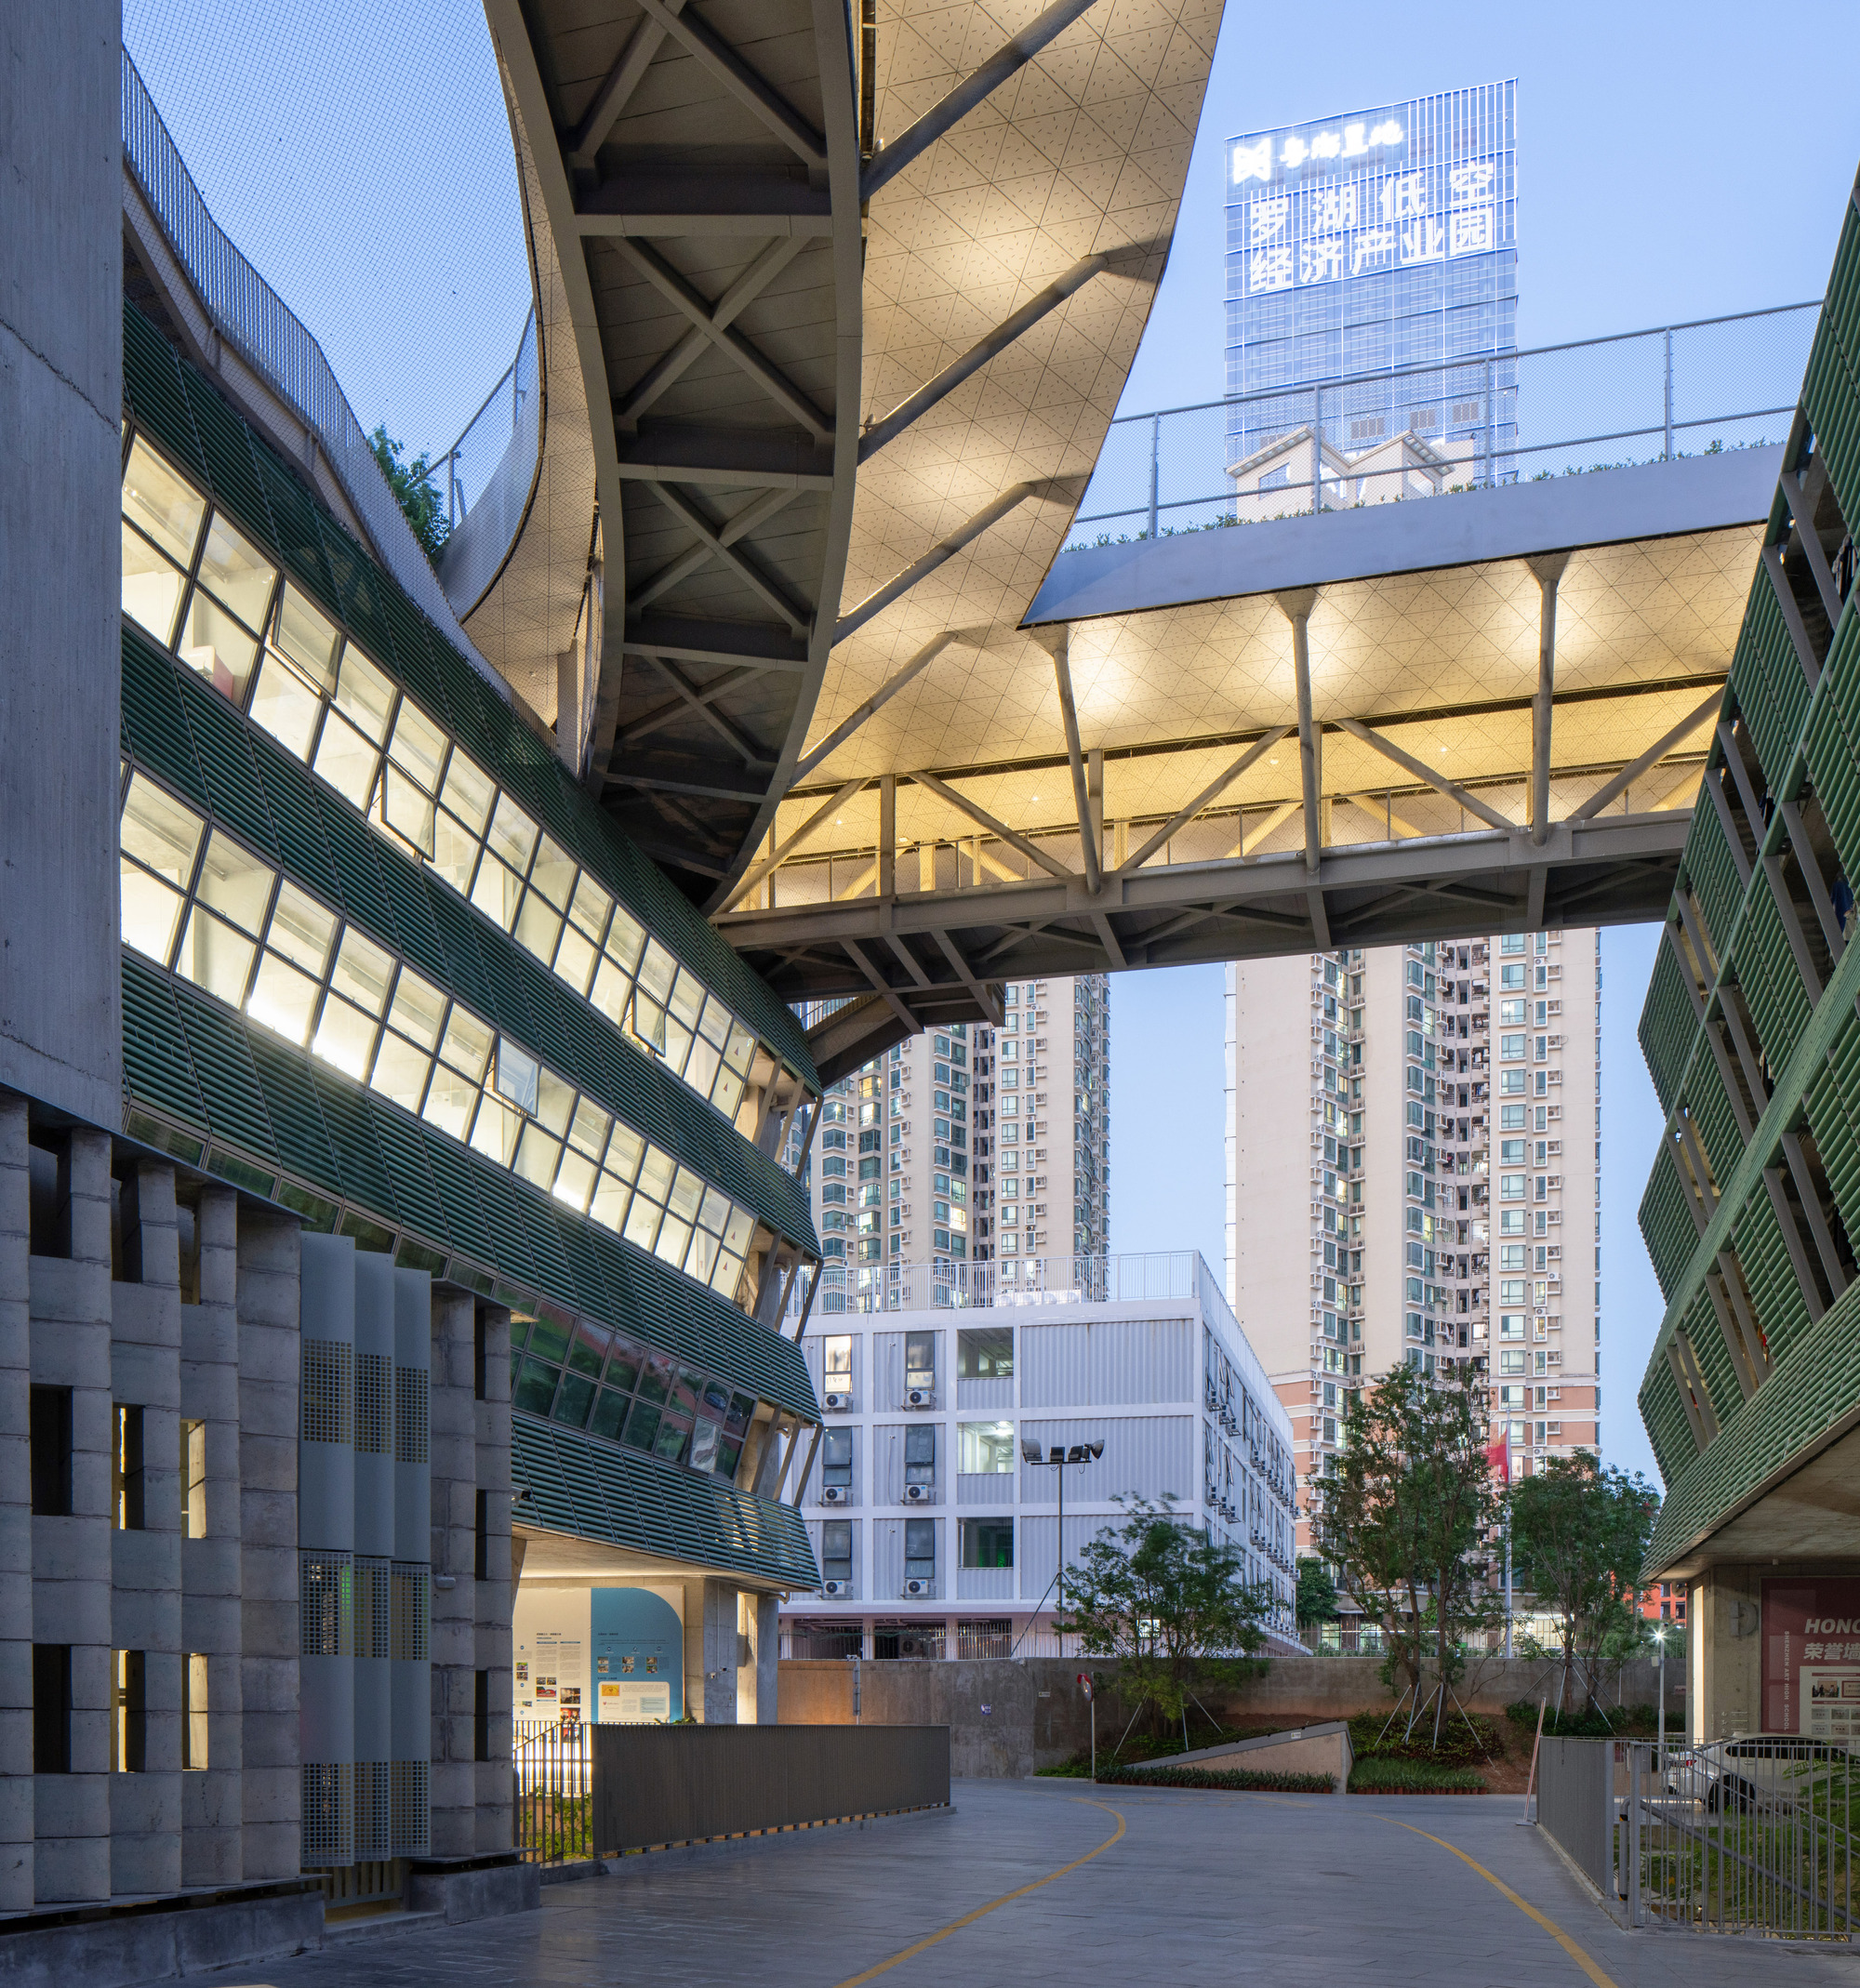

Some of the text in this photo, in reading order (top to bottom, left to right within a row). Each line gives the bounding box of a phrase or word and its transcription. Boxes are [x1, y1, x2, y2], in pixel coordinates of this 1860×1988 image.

[1250, 161, 1494, 245] 罗湖低空
[1250, 206, 1494, 293] 经济产业园
